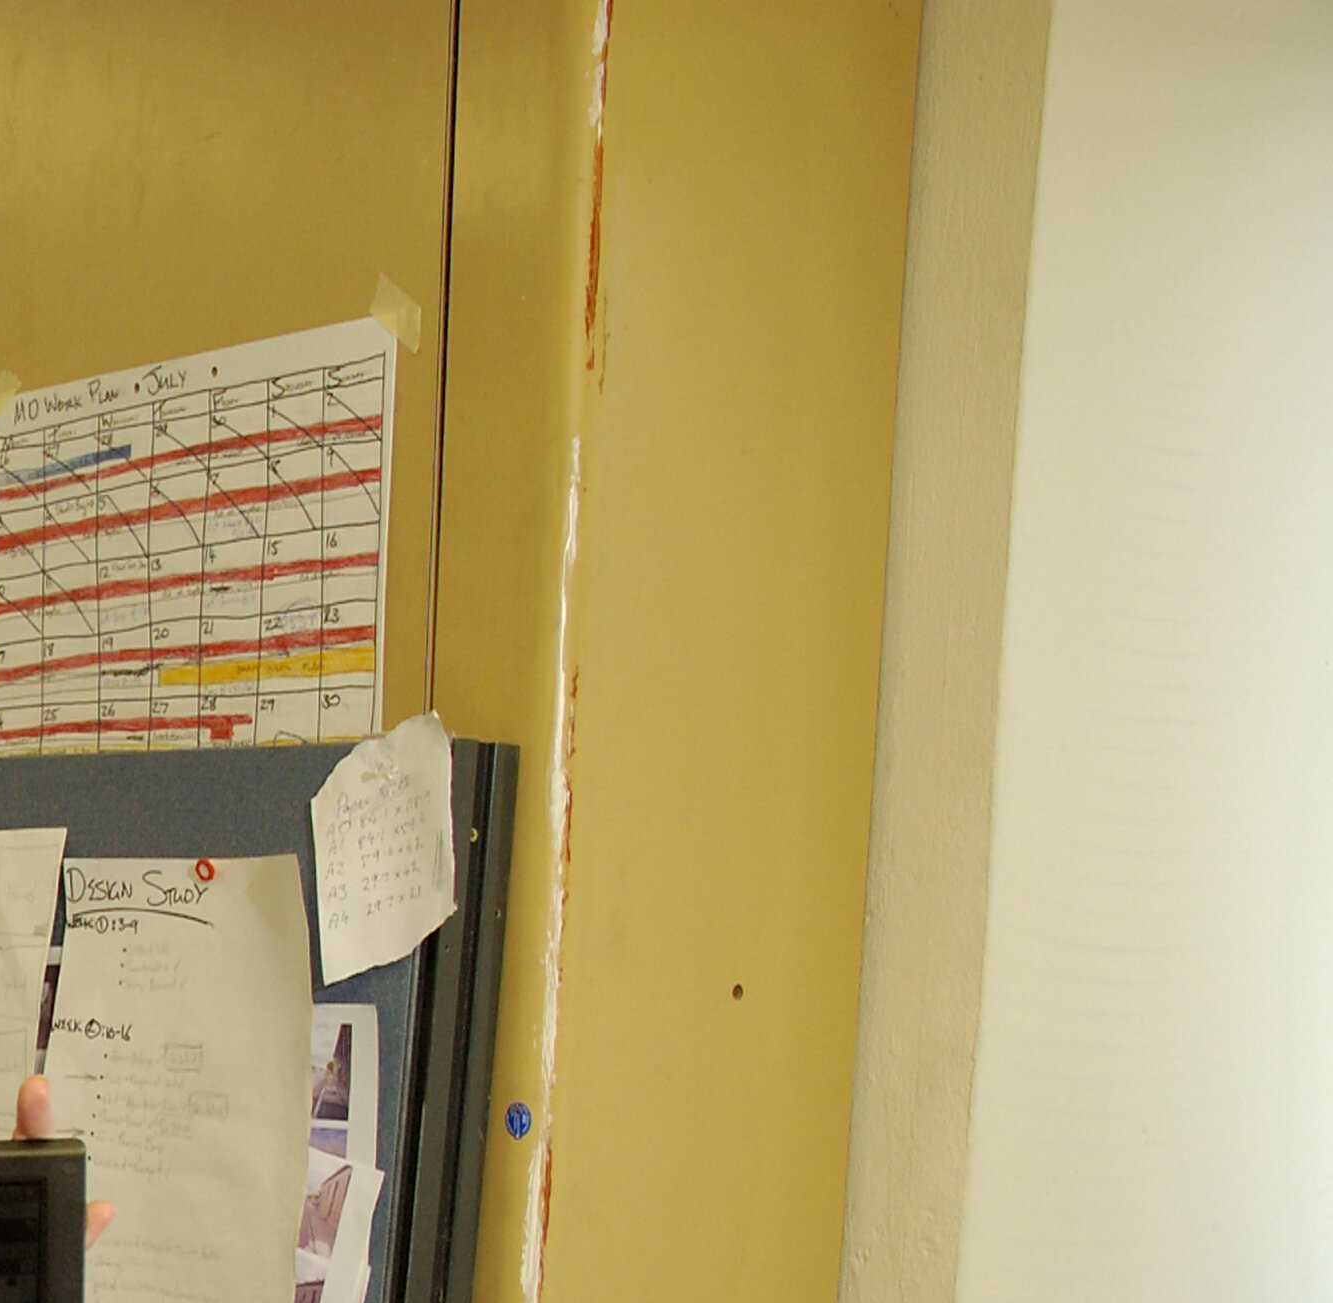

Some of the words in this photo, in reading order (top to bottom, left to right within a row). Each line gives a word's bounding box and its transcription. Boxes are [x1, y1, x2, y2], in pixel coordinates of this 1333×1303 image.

[142, 365, 187, 396] JULY
[266, 539, 282, 556] 15
[325, 532, 338, 549] 16
[323, 606, 341, 624] 23
[202, 621, 215, 636] 21
[264, 616, 283, 631] 22
[153, 627, 170, 641] 20
[42, 642, 55, 658] 18
[101, 637, 114, 651] 19
[152, 703, 168, 714] 27
[201, 696, 218, 711] 28
[260, 699, 275, 712] 29
[322, 694, 340, 709] 30
[44, 708, 59, 722] 25
[101, 704, 115, 718] 26
[67, 867, 133, 904] DESIGN
[141, 869, 209, 907] STUDY
